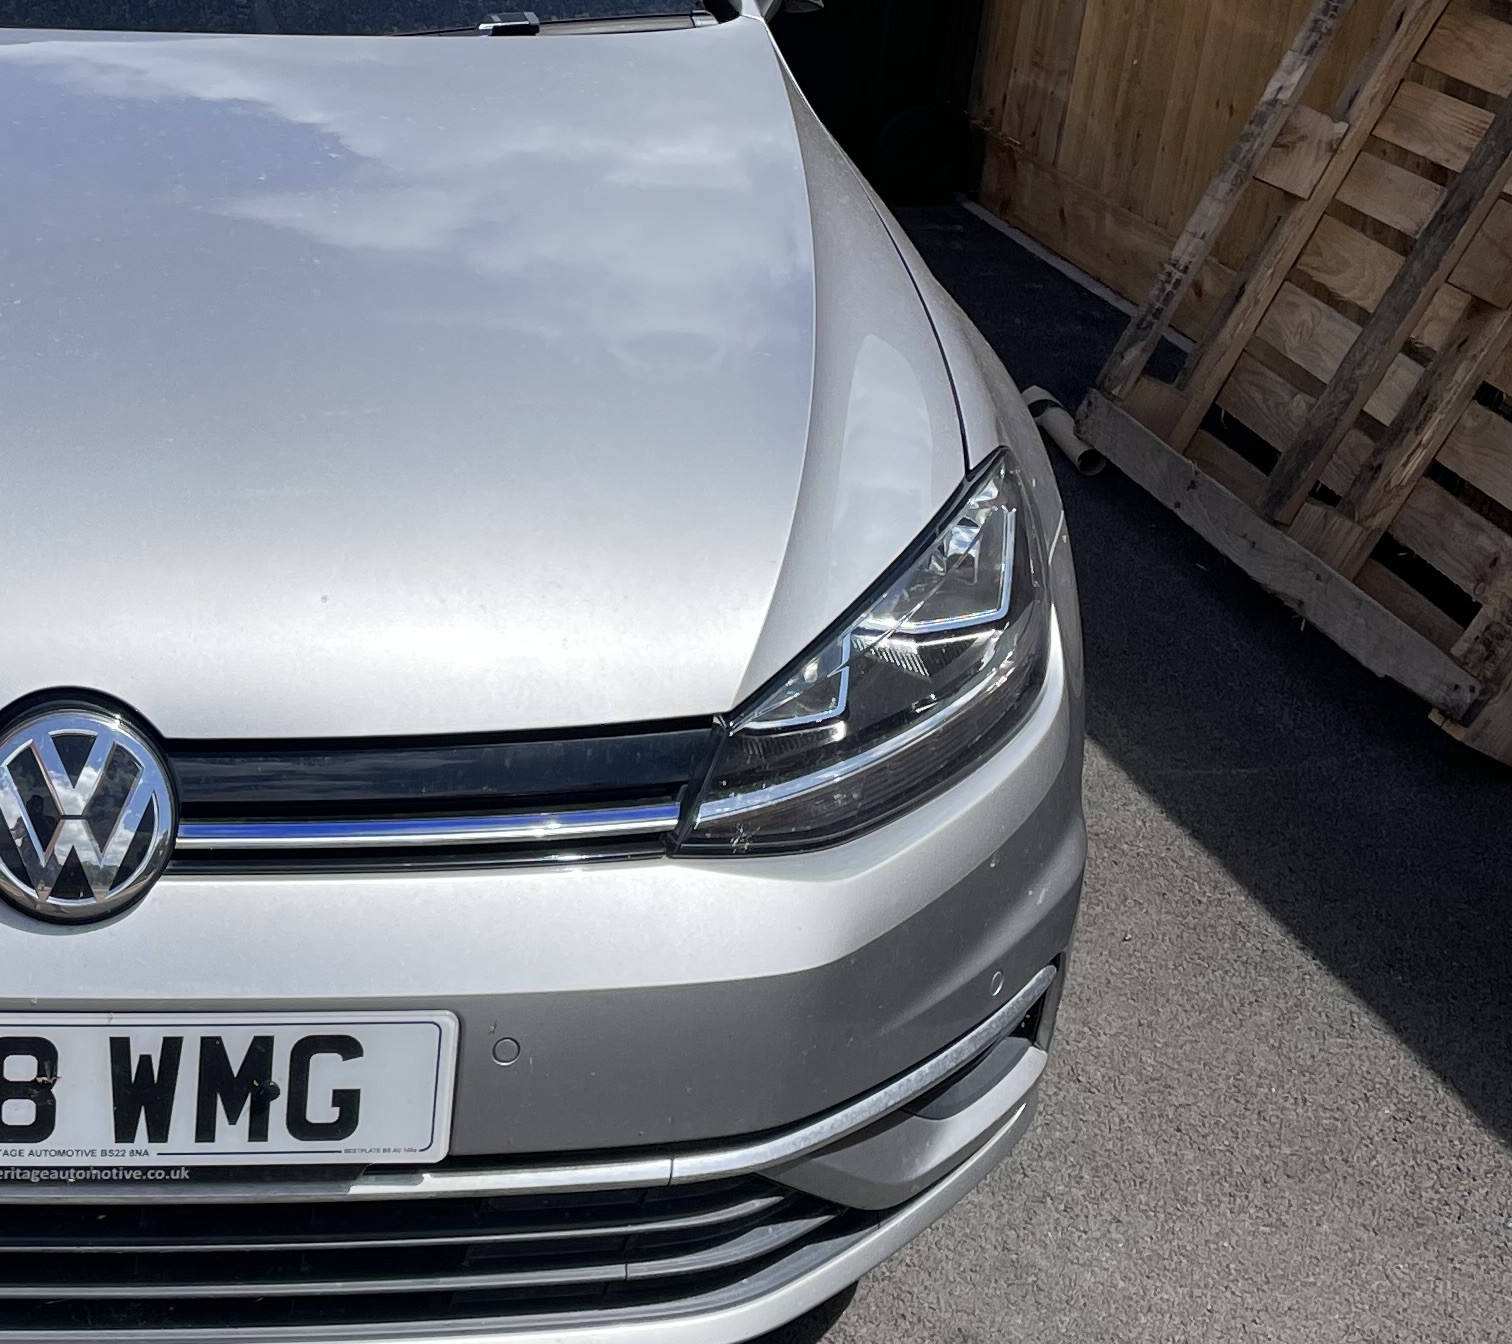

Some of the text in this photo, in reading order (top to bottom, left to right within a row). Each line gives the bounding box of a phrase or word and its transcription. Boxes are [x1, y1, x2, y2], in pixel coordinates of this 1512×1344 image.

[109, 1034, 364, 1143] WMG
[28, 1149, 97, 1158] AUTOMOTIVE
[100, 1149, 126, 1157] BS22
